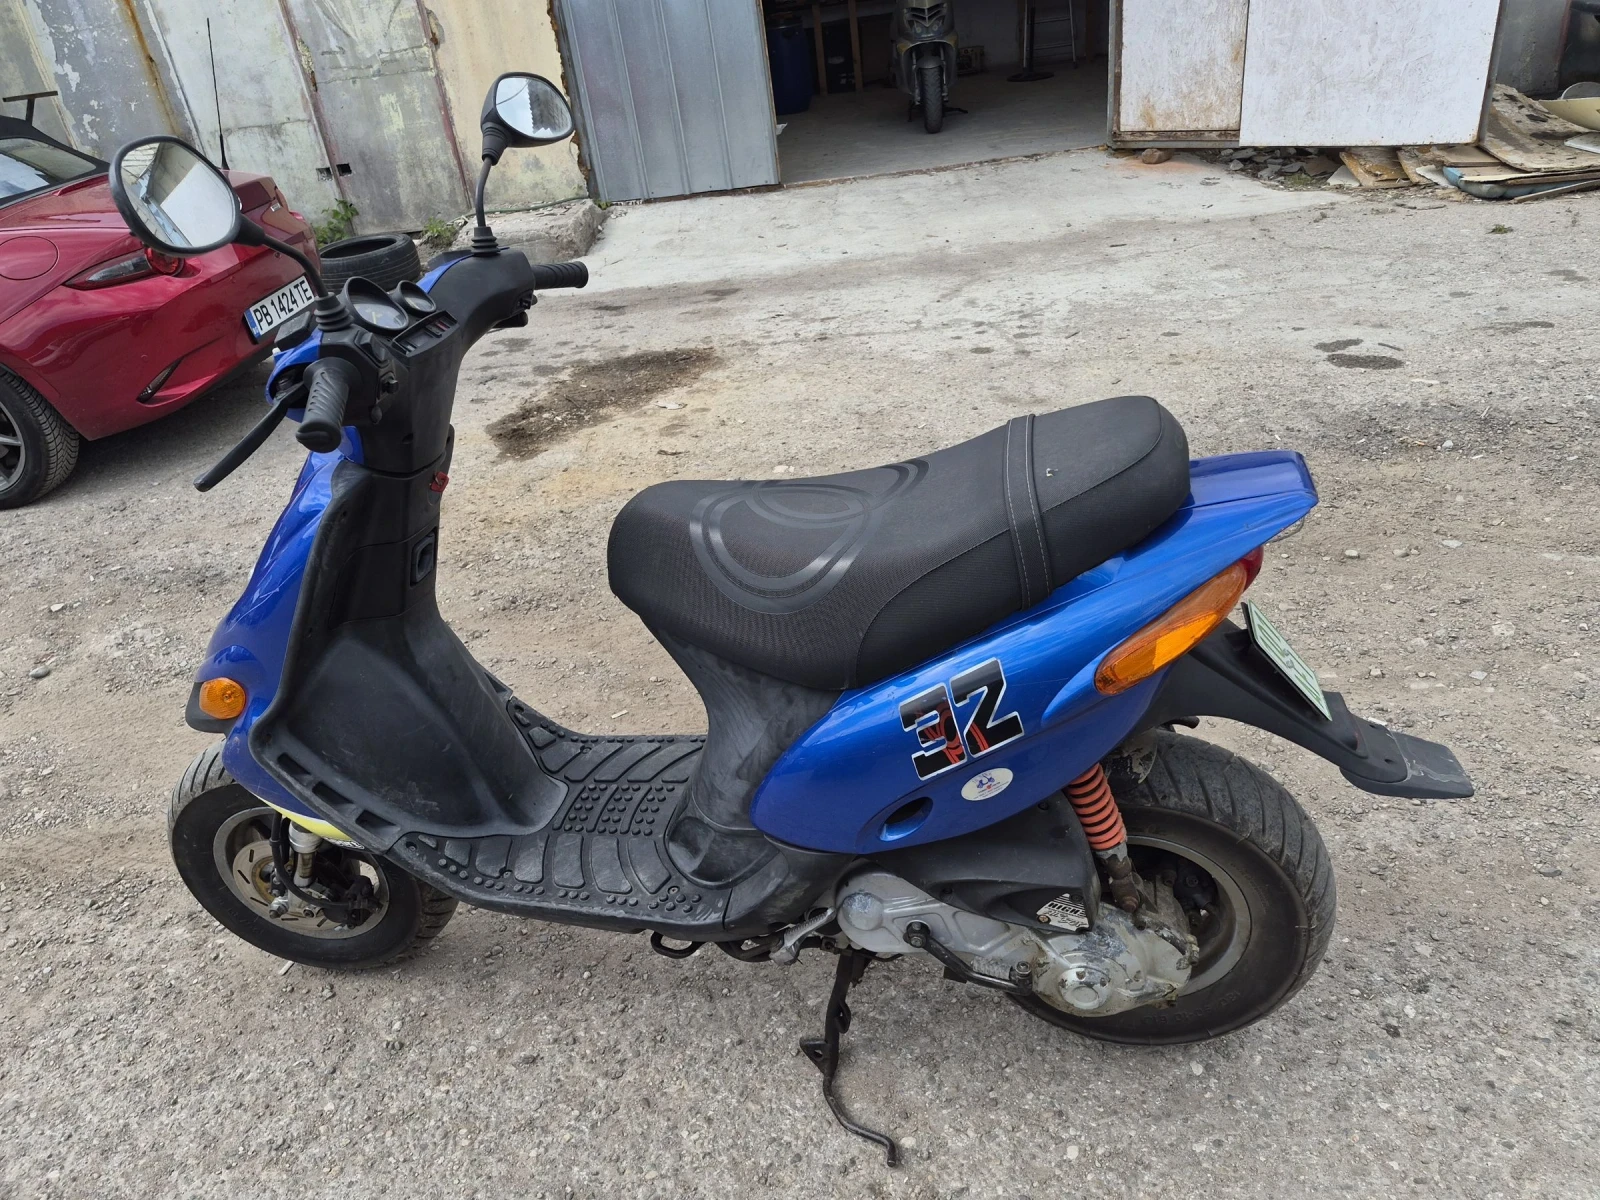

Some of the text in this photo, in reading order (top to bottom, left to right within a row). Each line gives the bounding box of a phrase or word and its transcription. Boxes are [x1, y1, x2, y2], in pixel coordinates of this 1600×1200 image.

[253, 280, 312, 330] PB 1424 TE
[898, 657, 1025, 781] 32
[1048, 903, 1080, 915] HIGH
